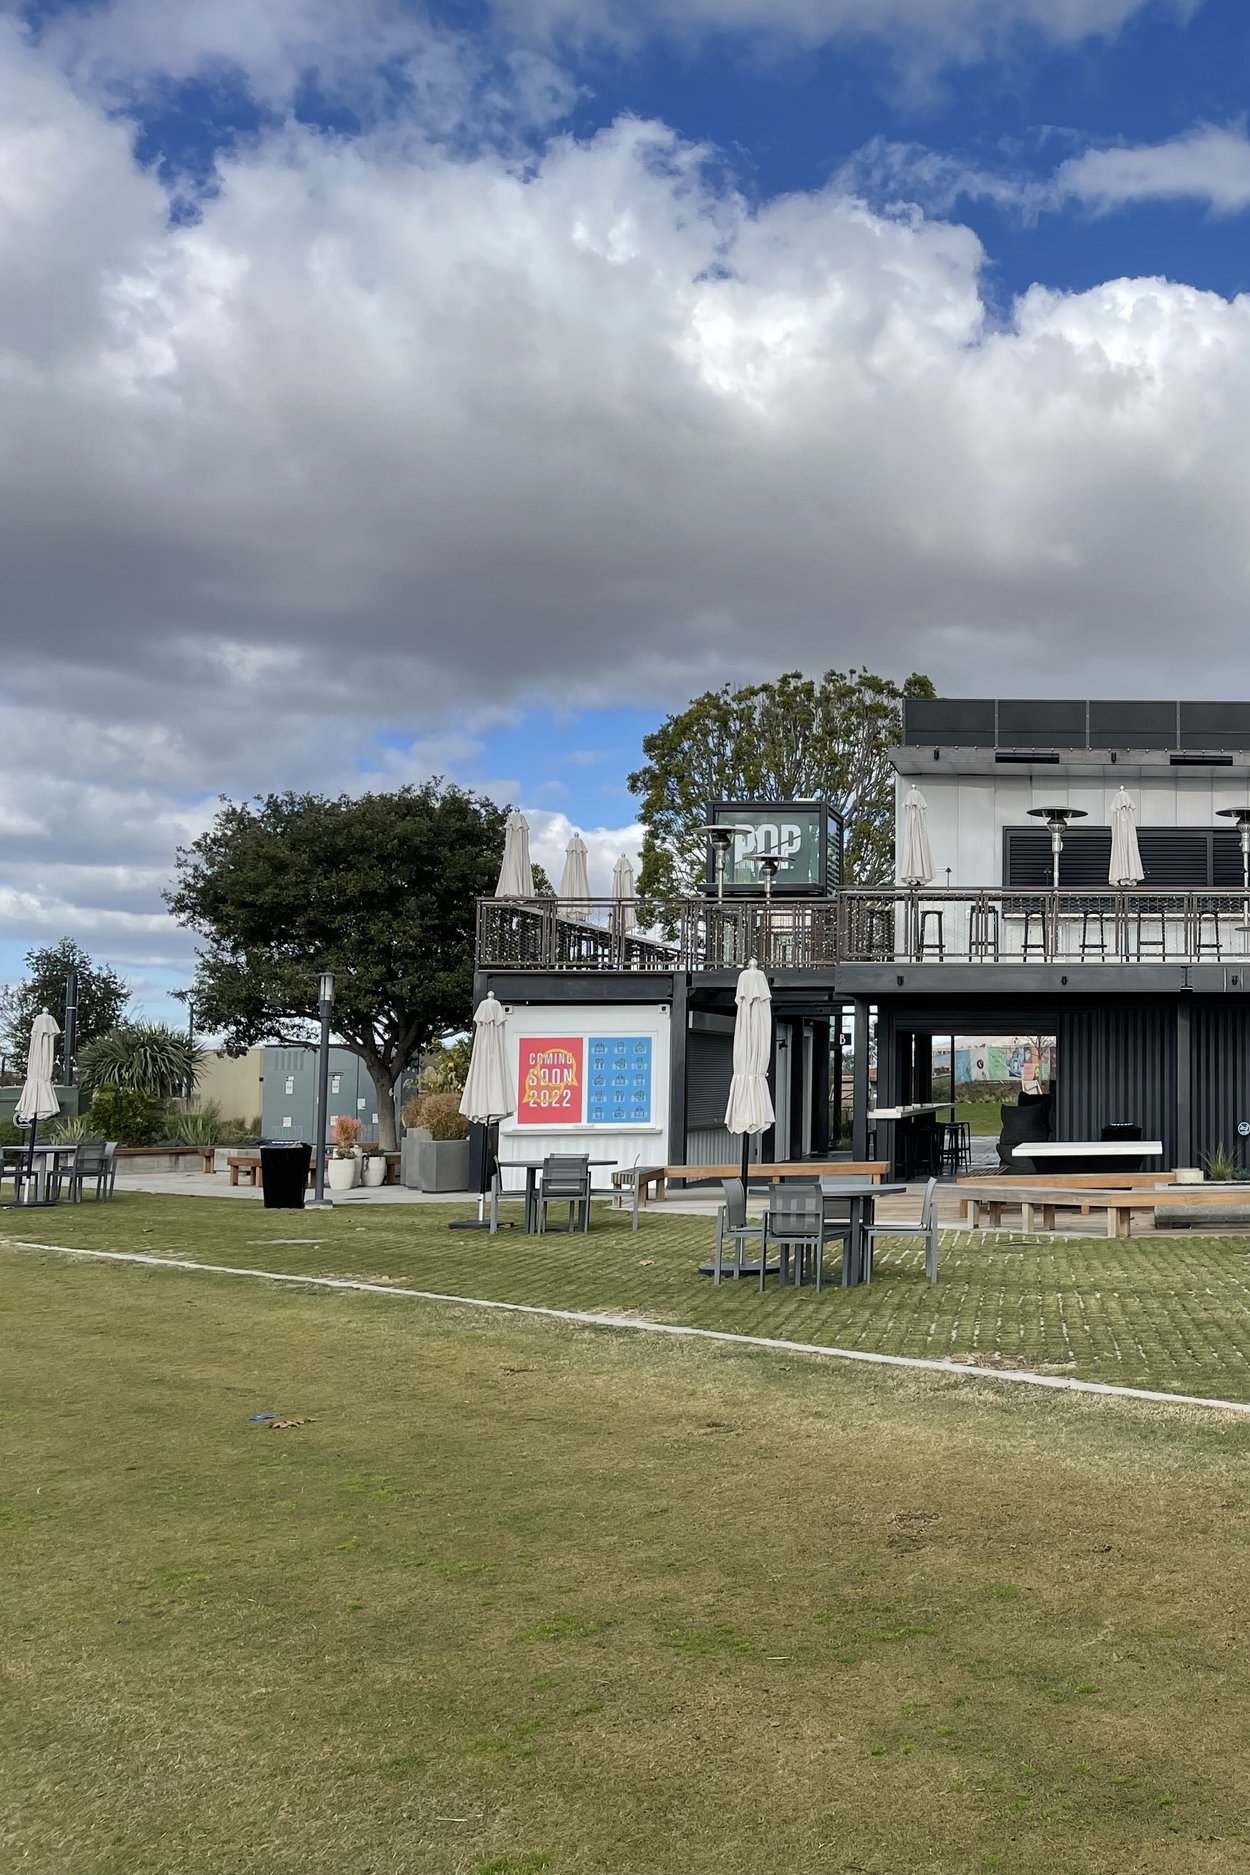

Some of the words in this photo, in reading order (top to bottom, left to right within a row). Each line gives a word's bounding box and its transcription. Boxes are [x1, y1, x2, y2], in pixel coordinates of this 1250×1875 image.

[839, 1033, 846, 1045] B
[529, 1052, 573, 1065] COMING
[529, 1068, 572, 1086] SOON
[529, 1089, 571, 1107] 2022
